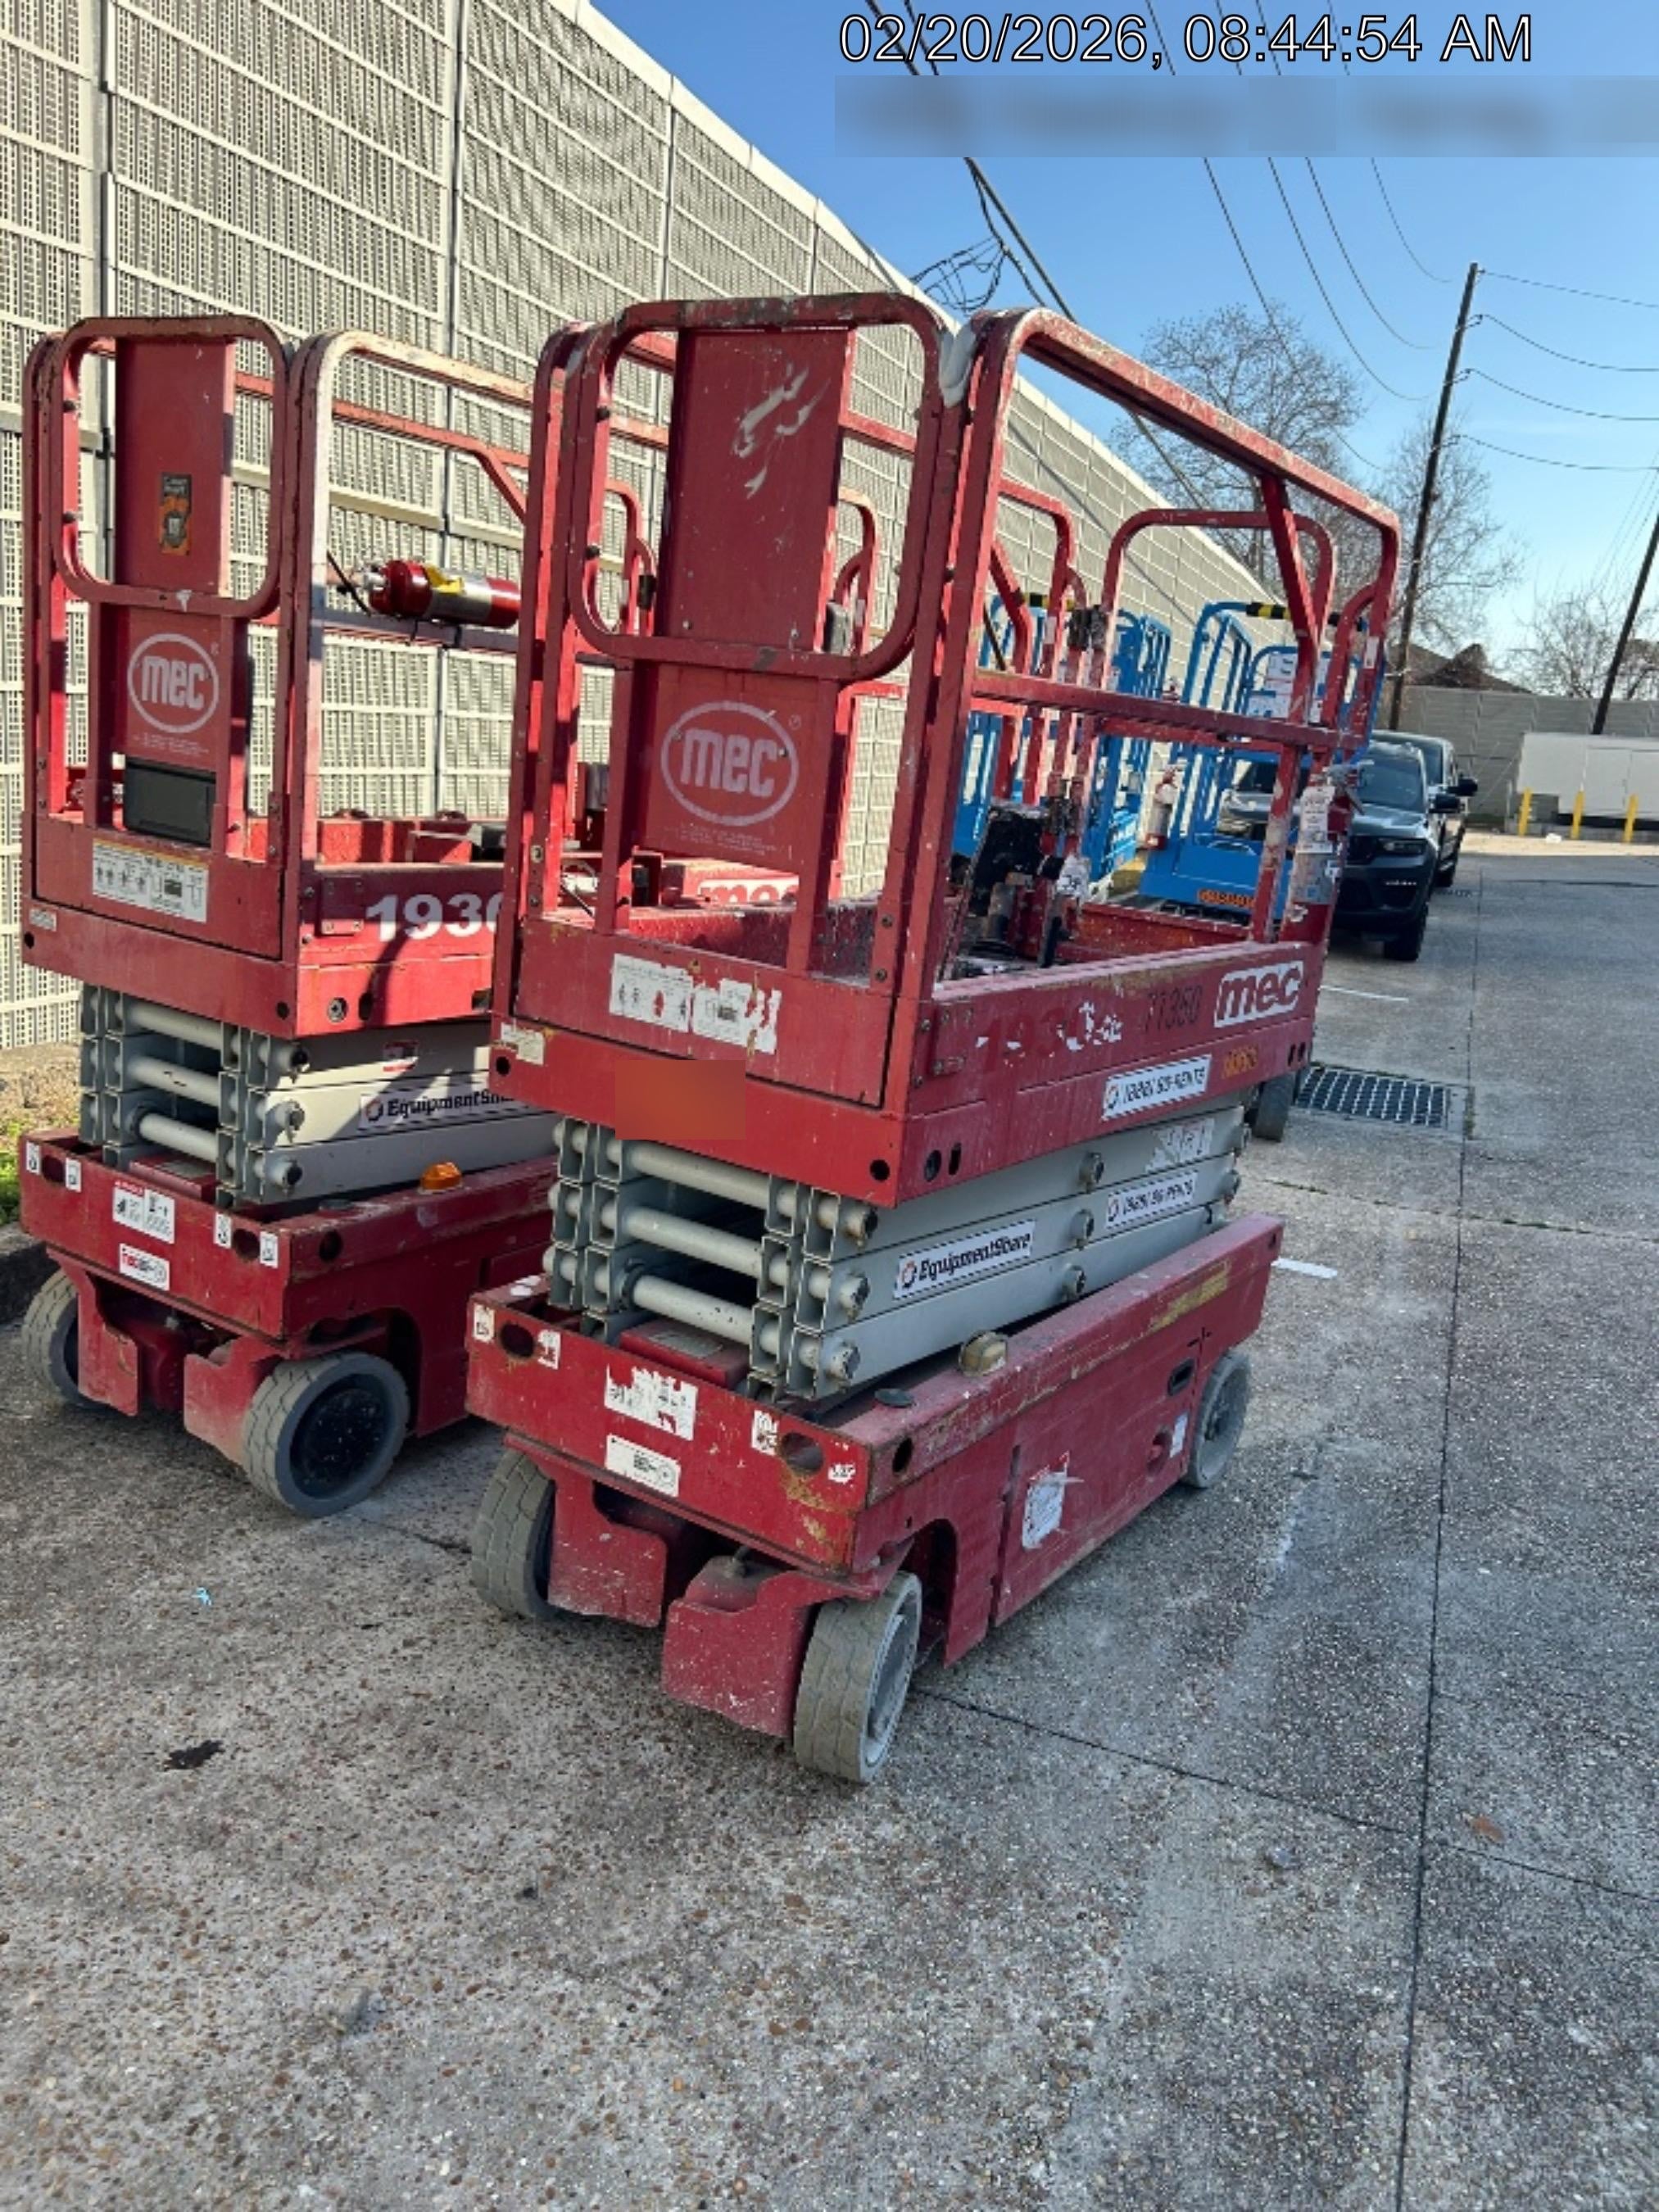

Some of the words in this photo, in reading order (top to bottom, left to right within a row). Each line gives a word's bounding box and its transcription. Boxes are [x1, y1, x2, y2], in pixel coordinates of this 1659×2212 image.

[141, 655, 205, 710] mec
[680, 728, 778, 798] mec
[1217, 968, 1301, 1021] mec
